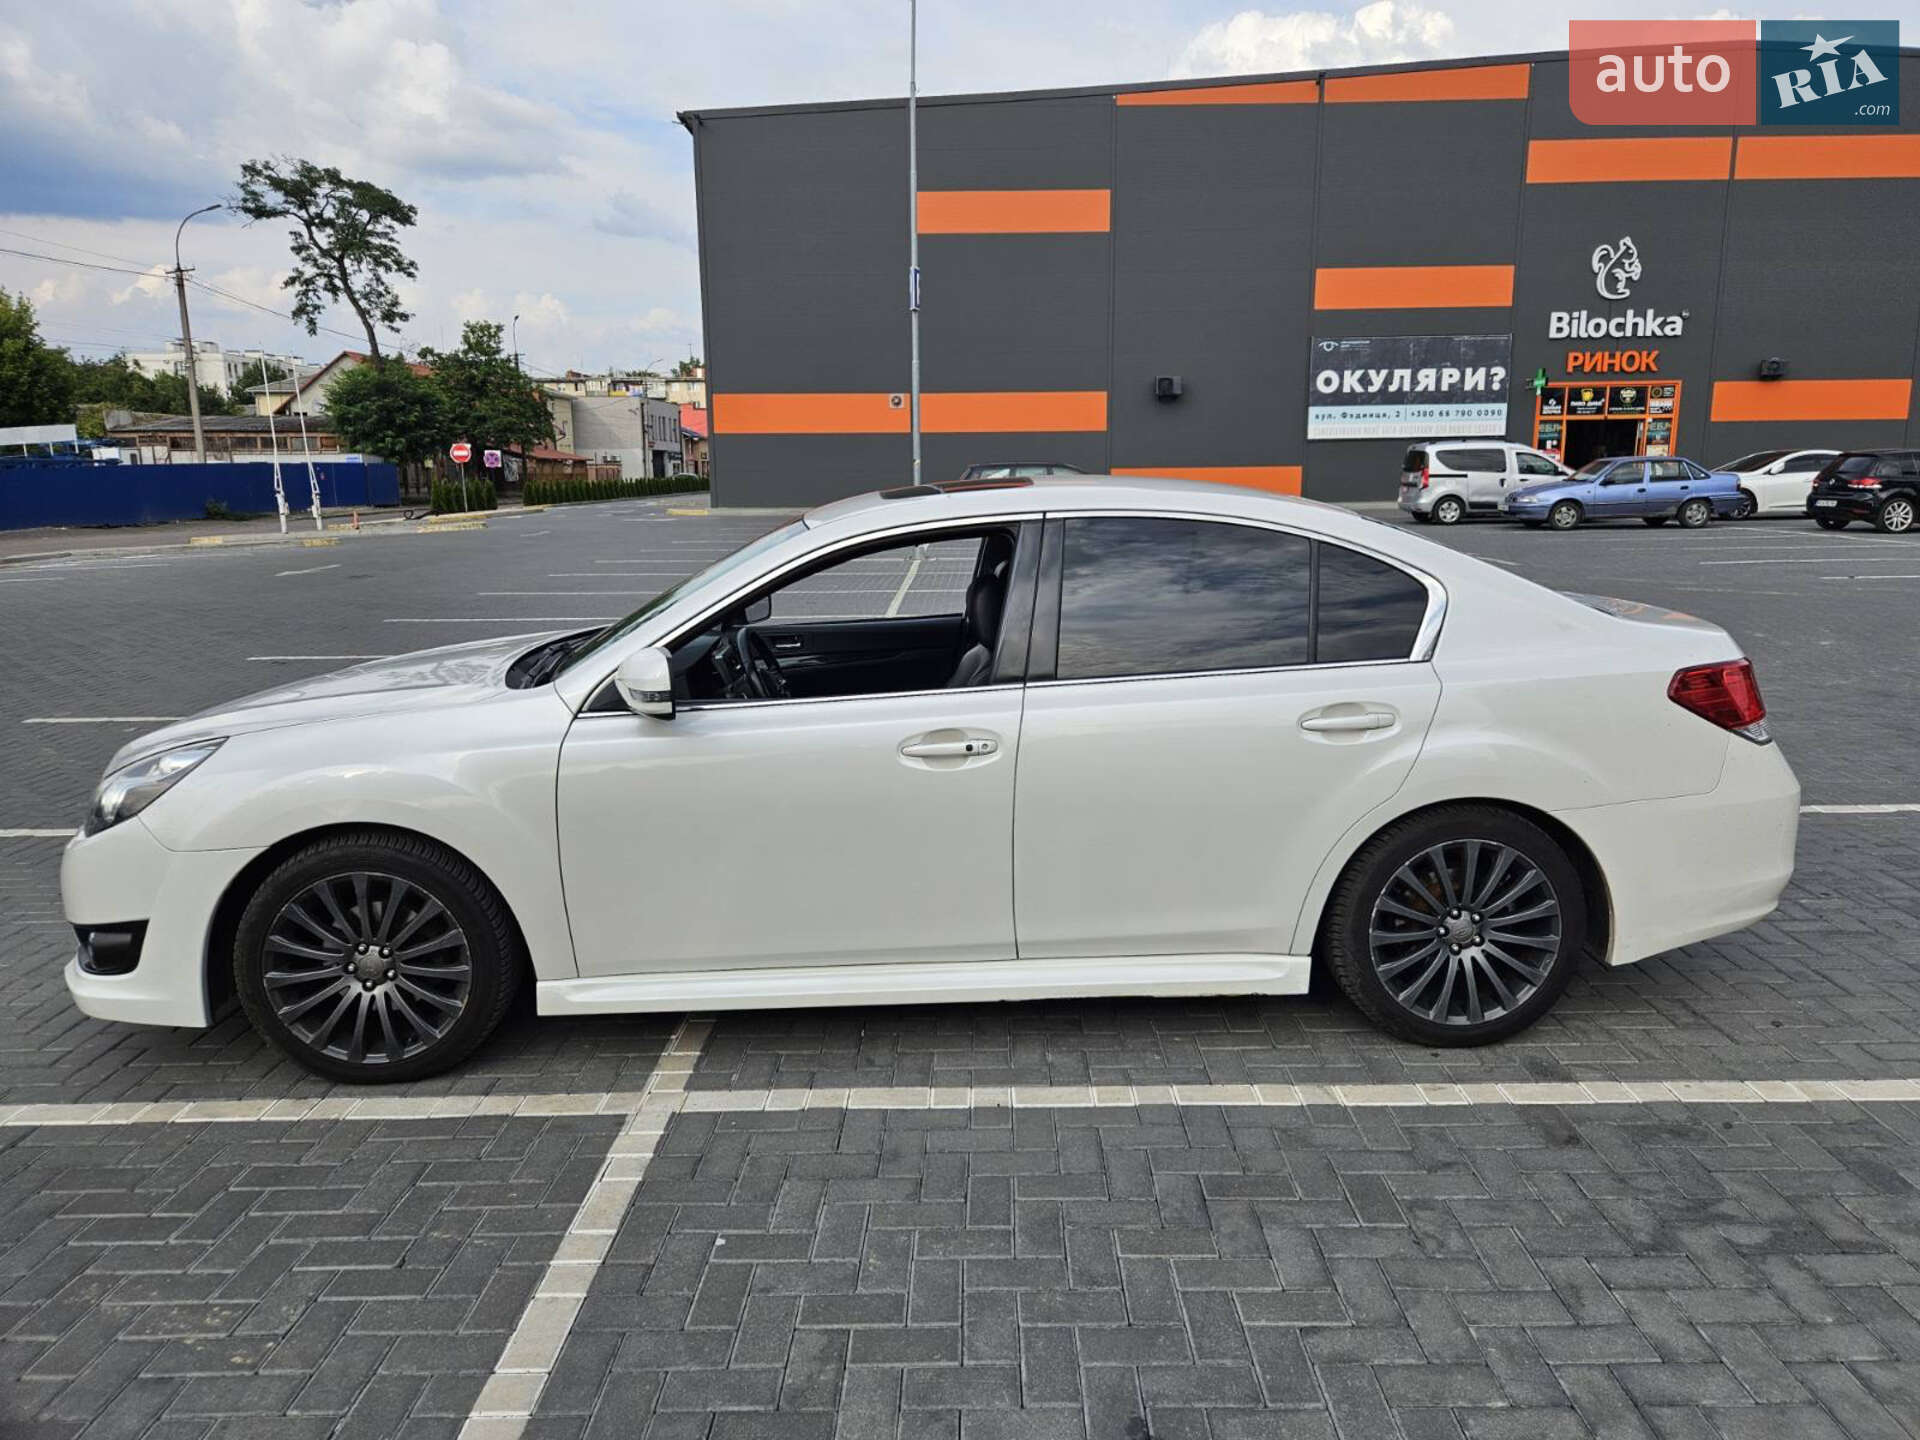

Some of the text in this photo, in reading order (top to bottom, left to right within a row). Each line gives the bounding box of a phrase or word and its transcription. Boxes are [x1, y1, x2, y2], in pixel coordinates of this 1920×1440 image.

[1548, 309, 1684, 339] Bilochka
[1566, 350, 1659, 373] РИНОК
[1315, 366, 1507, 394] ОКУЛЯРИ?
